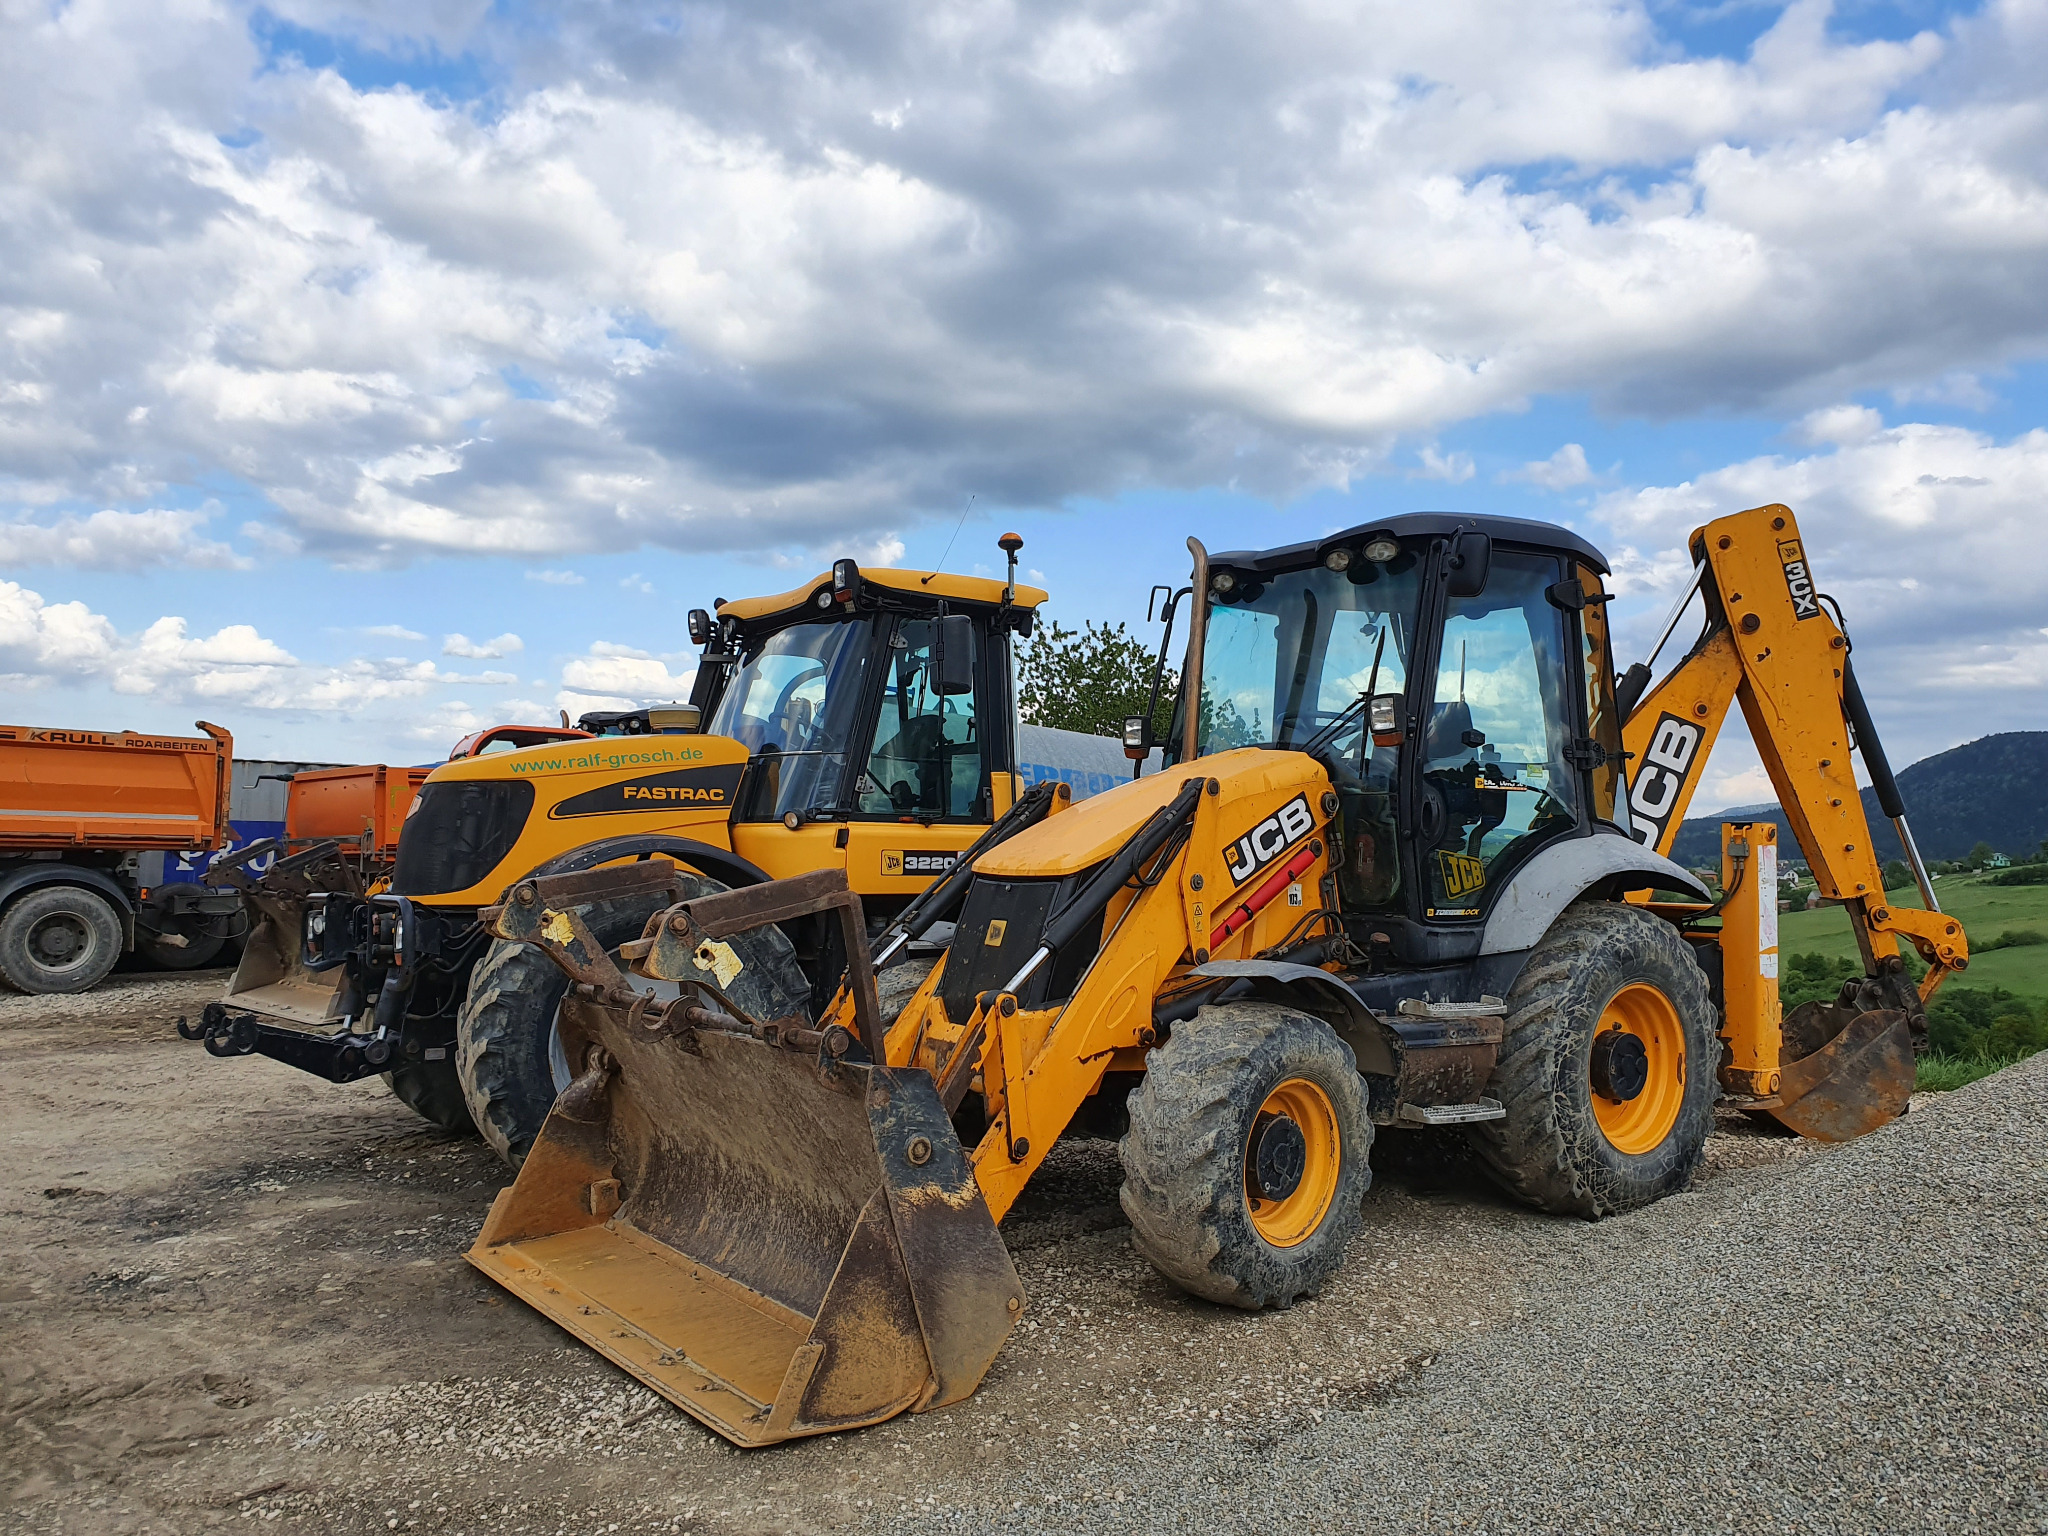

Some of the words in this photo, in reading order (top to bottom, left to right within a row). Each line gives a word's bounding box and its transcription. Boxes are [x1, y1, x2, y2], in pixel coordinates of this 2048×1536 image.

[1785, 561, 1818, 614] 3CX
[30, 731, 114, 746] KRULL
[510, 747, 704, 773] www.ralf-grosch.de
[623, 786, 725, 801] FASTRAC
[1231, 798, 1312, 881] JCB
[887, 856, 901, 869] JCB
[904, 856, 956, 870] 3220
[1447, 856, 1481, 894] JCB
